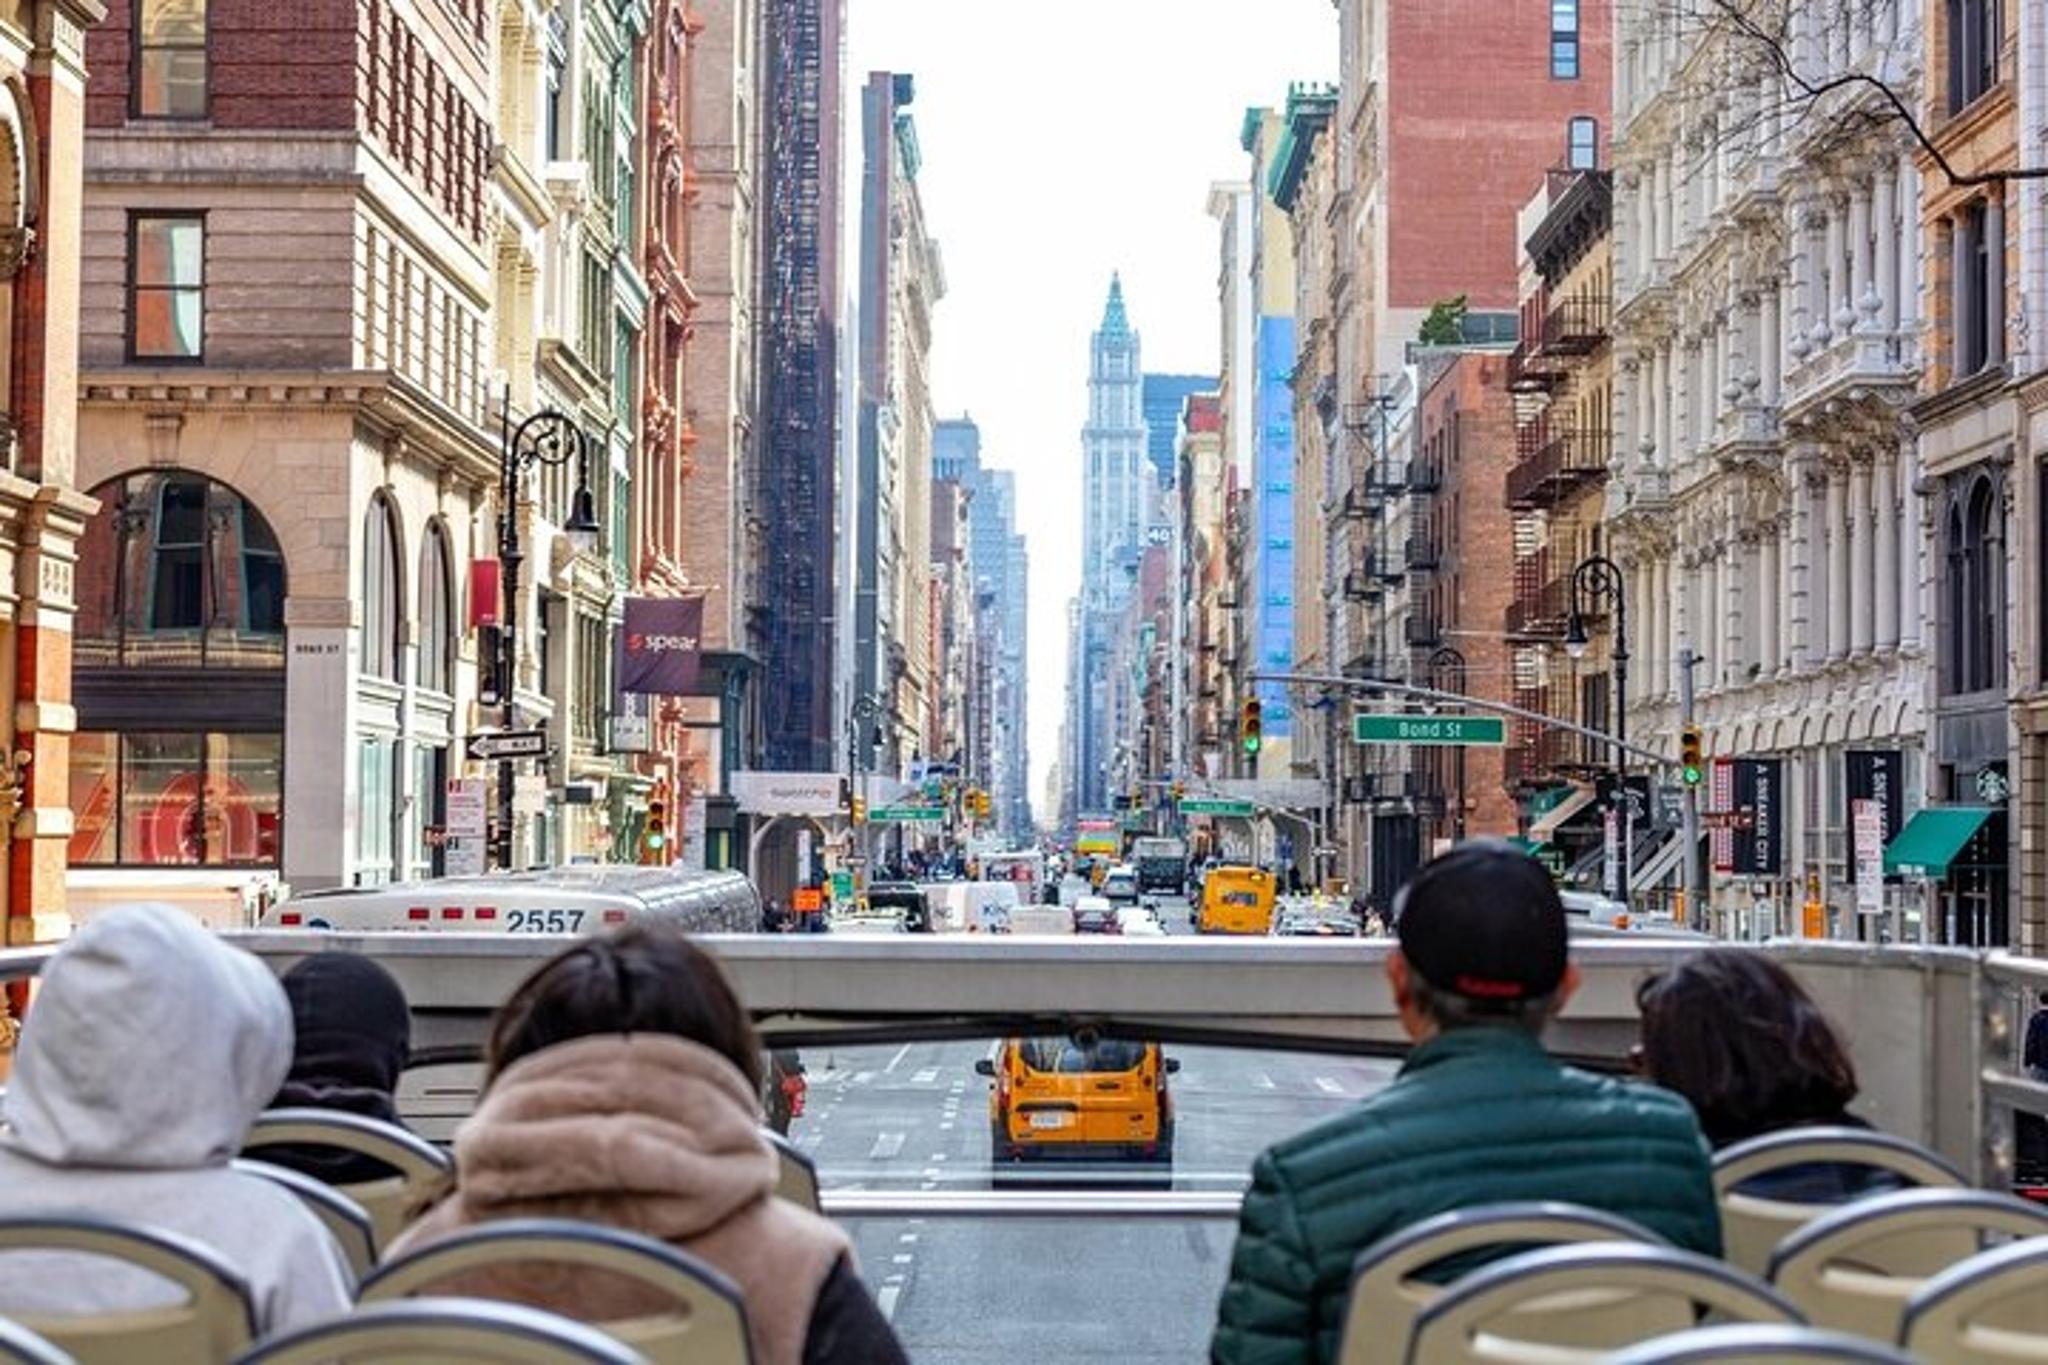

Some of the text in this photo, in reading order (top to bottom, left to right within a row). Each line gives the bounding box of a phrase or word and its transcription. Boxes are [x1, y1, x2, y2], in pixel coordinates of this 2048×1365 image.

[645, 636, 697, 652] spear
[1399, 722, 1462, 737] Bond St
[1873, 756, 1888, 769] A
[1756, 764, 1770, 872] A SNEAKER CITY
[507, 909, 585, 933] 2557
